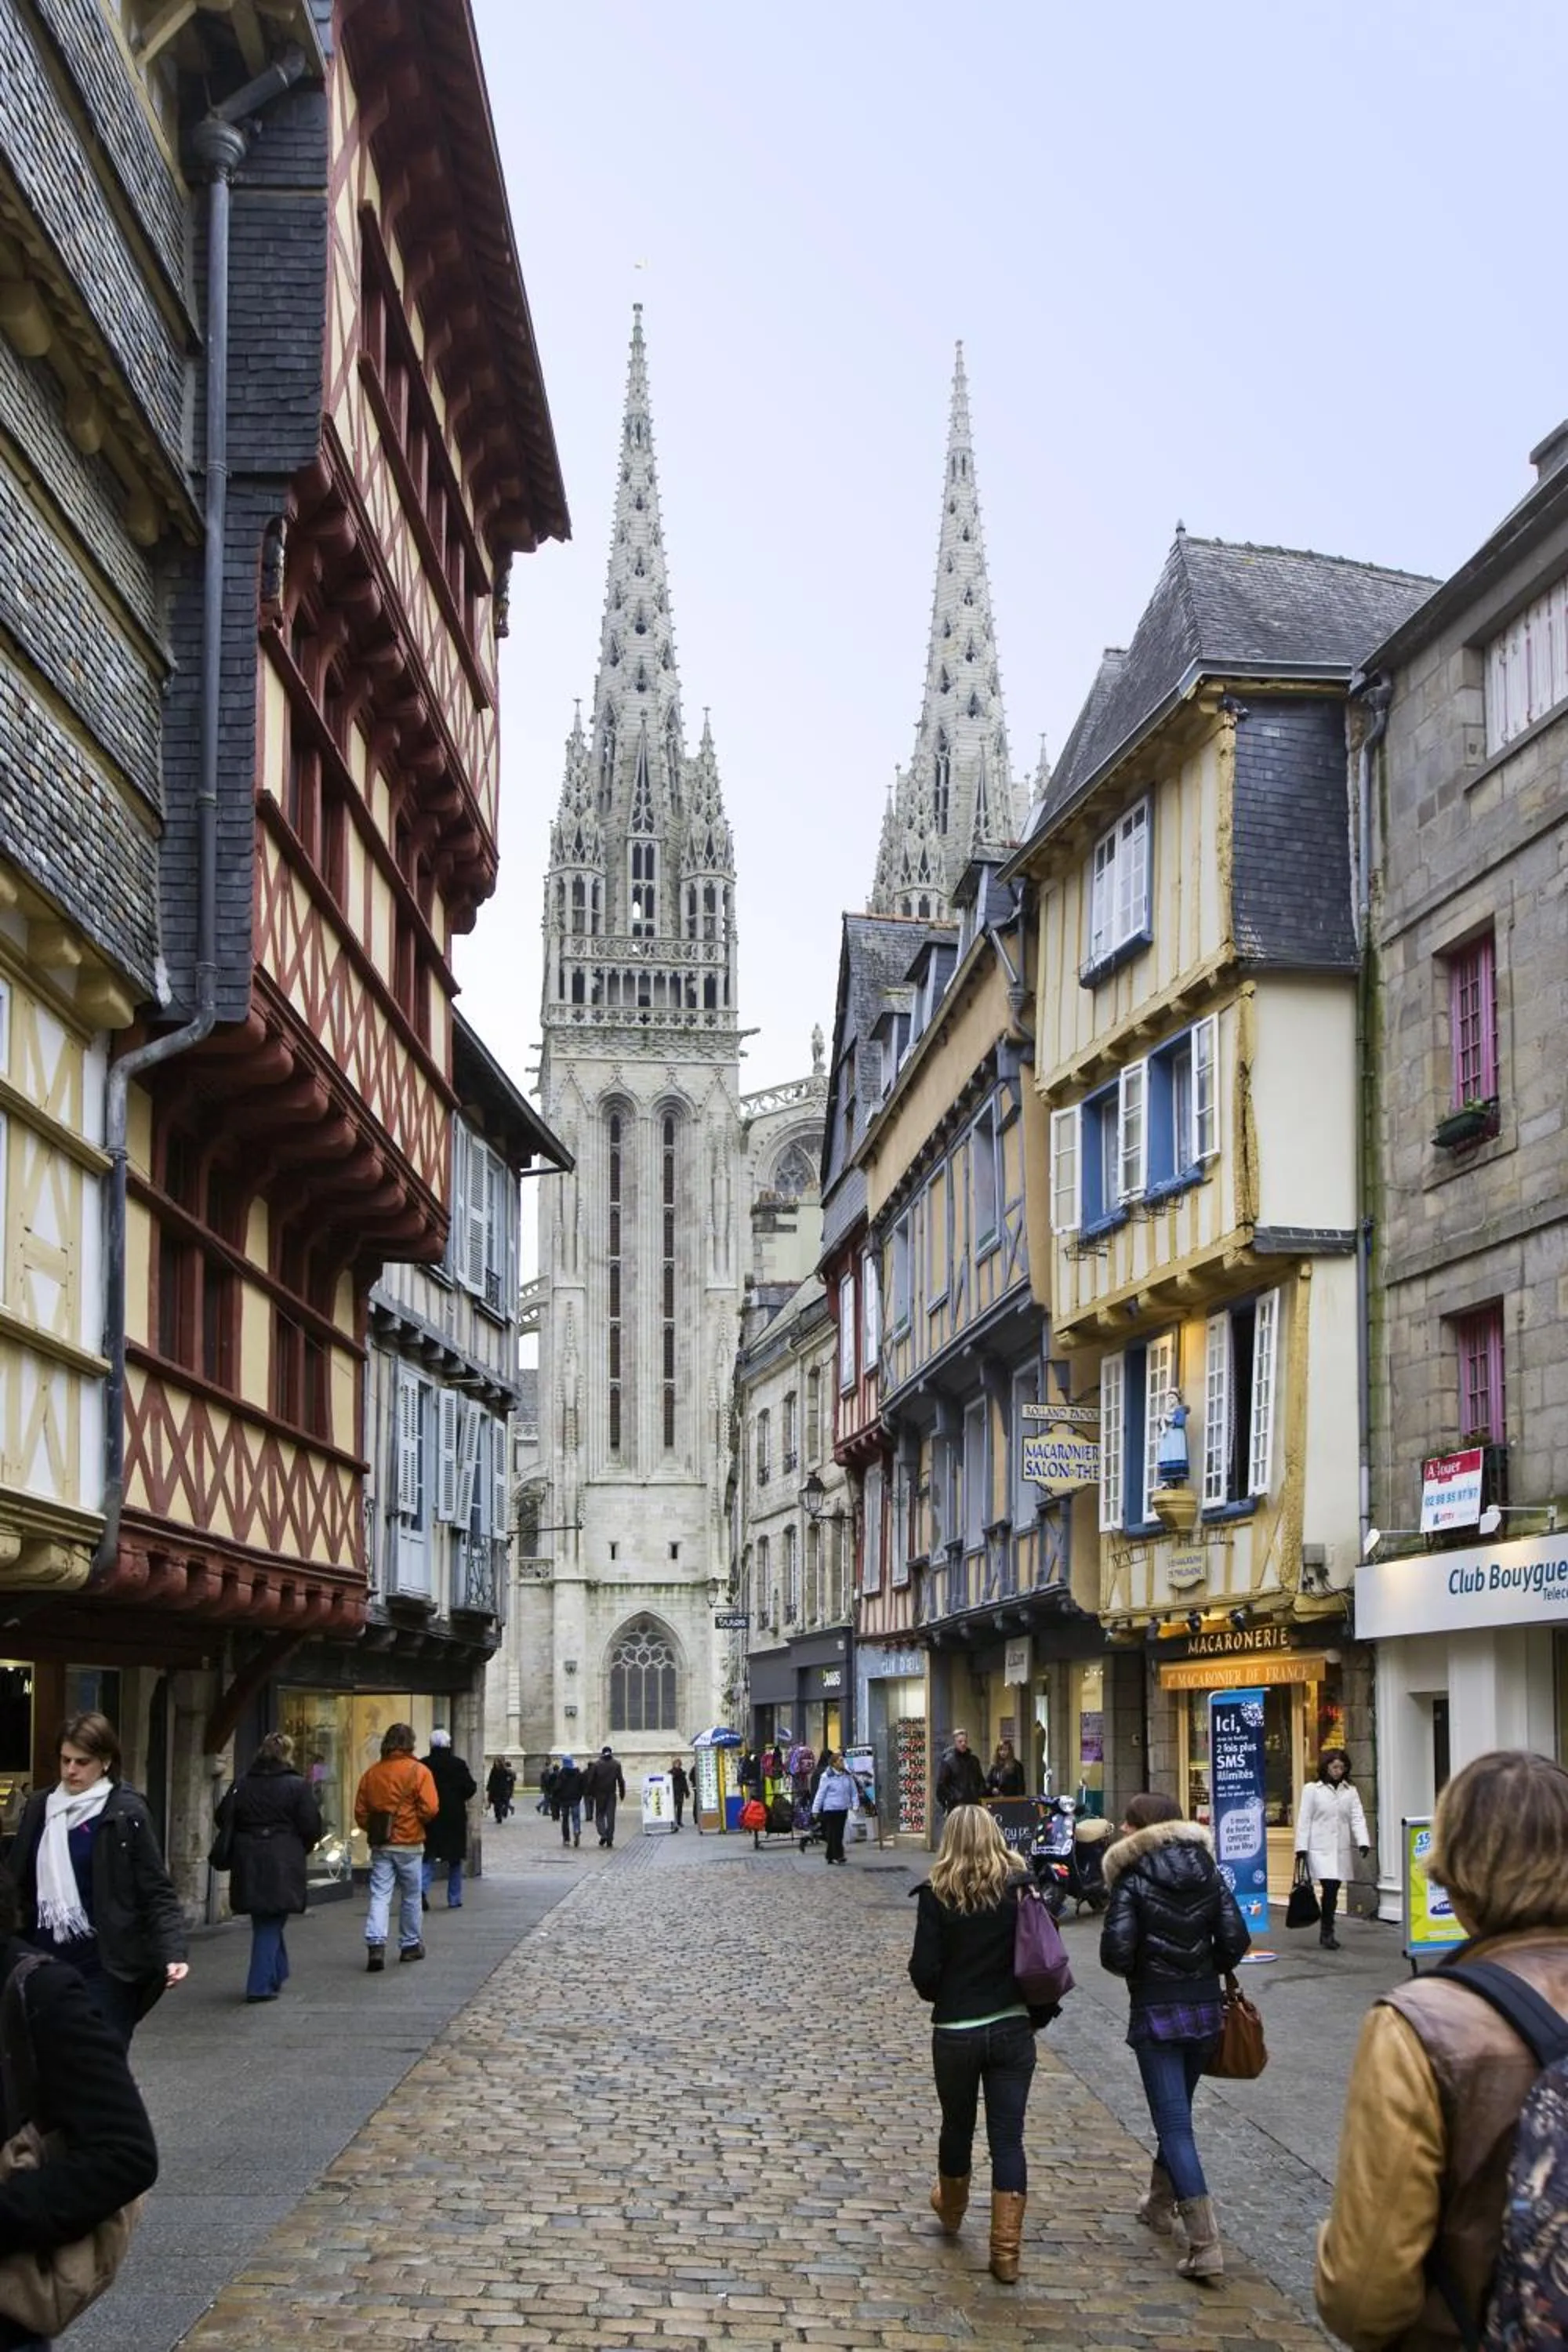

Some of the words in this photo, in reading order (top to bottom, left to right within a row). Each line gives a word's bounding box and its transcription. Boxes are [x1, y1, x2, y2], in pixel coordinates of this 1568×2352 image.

[1025, 1461, 1069, 1478] SALON
[1448, 1566, 1486, 1595] Club
[1188, 1627, 1289, 1655] MACARONERIE
[1246, 1667, 1261, 1683] DE
[1216, 1714, 1241, 1733] Ici,
[1216, 1745, 1222, 1754] 2
[1240, 1741, 1257, 1754] plus
[1217, 1754, 1246, 1769] SMS
